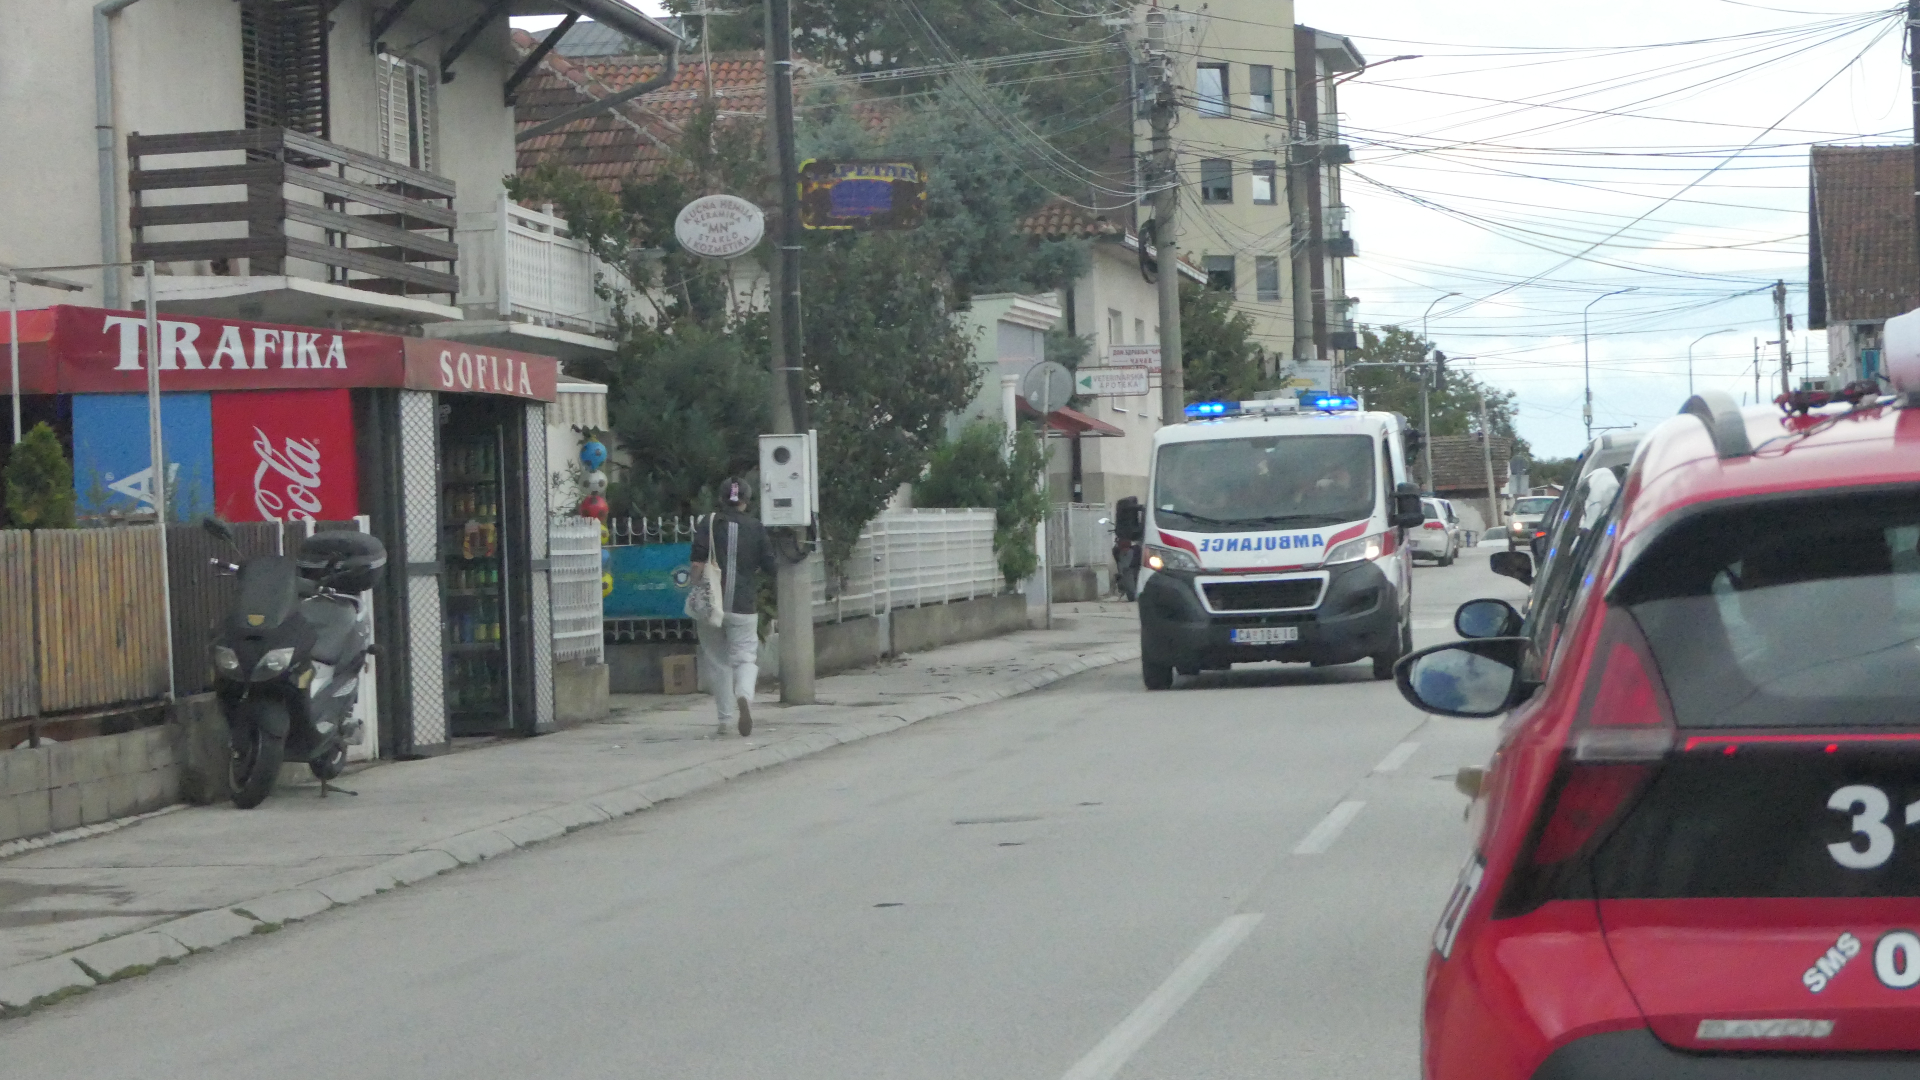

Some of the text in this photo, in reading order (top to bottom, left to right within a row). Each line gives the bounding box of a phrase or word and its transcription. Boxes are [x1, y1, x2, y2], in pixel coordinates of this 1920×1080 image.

[693, 209, 741, 225] KERAMIKA
[693, 236, 750, 253] KOZMETIKA
[698, 231, 739, 243] STAKLO
[103, 315, 348, 371] TRAFIKA
[440, 349, 534, 396] SOFIJA
[1093, 373, 1144, 382] VETERINARSKA
[1099, 381, 1138, 389] APOTEKA
[1802, 932, 1862, 994] SMS
